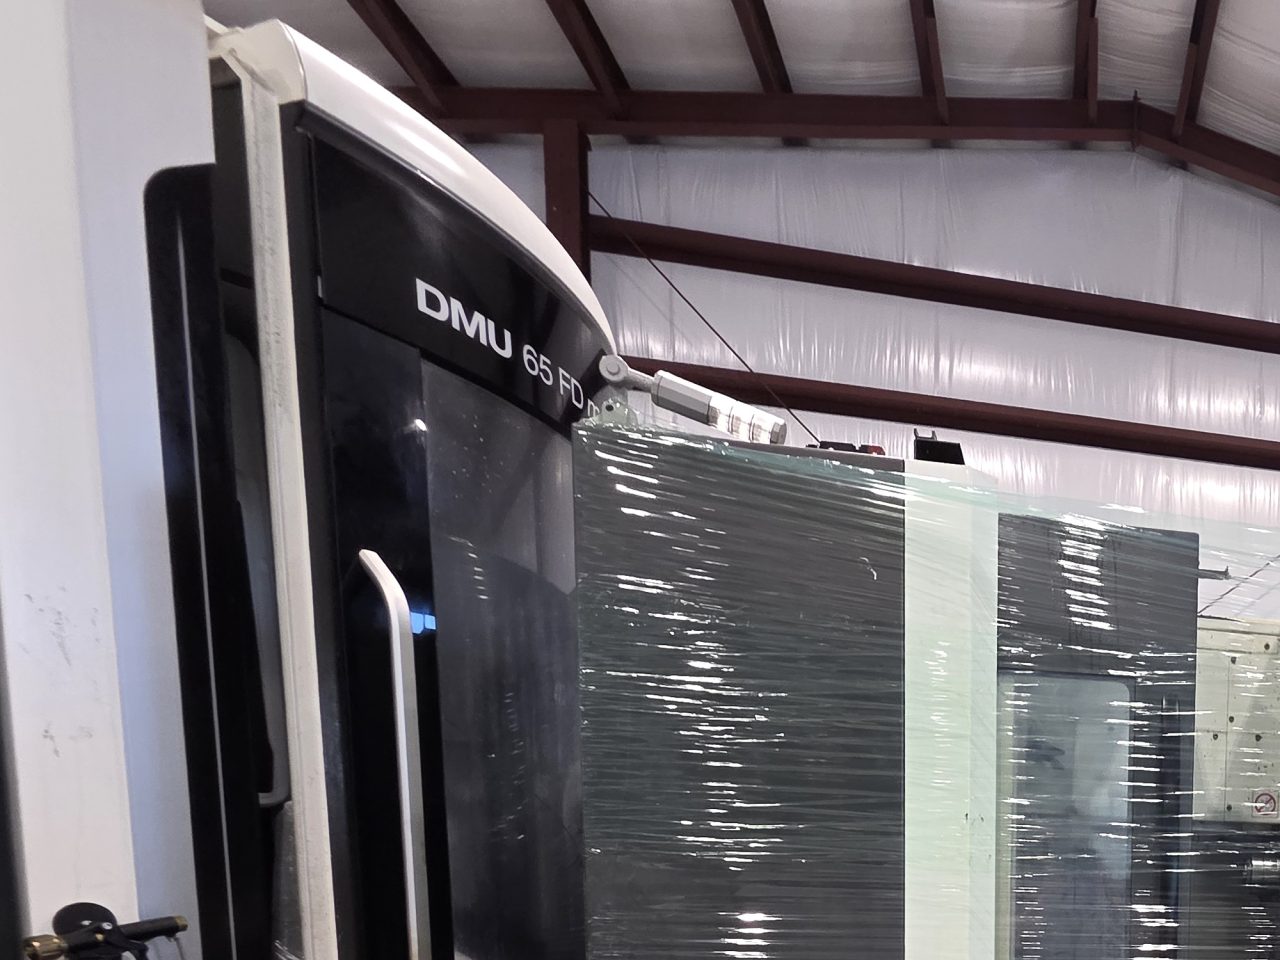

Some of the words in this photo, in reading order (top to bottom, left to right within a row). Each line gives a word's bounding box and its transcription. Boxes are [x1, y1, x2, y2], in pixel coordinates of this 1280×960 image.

[415, 277, 513, 359] DMU
[522, 344, 555, 387] 65
[558, 366, 584, 410] FD
